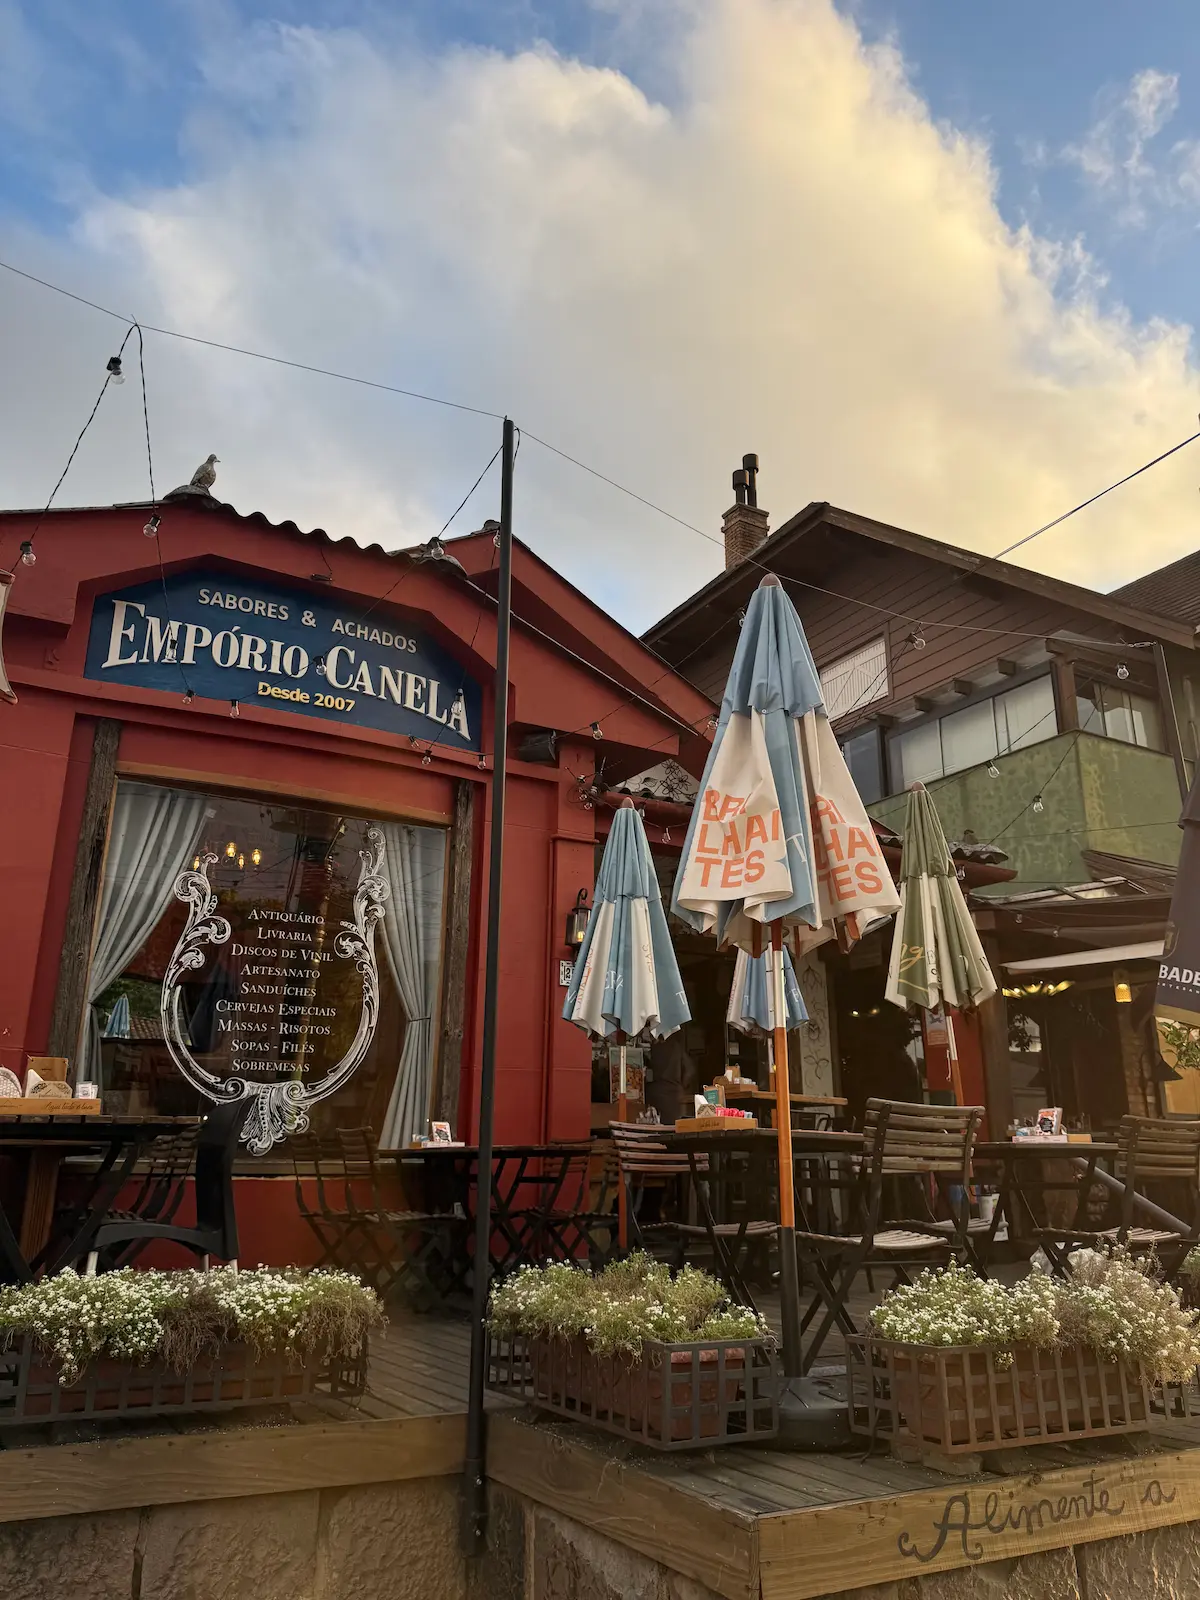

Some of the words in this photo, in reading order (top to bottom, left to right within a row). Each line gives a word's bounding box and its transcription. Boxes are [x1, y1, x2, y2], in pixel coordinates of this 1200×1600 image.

[198, 588, 289, 620] SABORES
[301, 610, 317, 628] &
[331, 619, 417, 654] ACHADOS
[101, 600, 309, 678] EMPÓRIO
[326, 645, 471, 741] CANELA
[257, 682, 310, 704] Desde
[313, 693, 356, 712] 2007
[695, 849, 765, 888] TES
[248, 909, 325, 924] ANTIQUÁRIO
[257, 926, 312, 941] LIVRARIA
[231, 943, 277, 957] DISCOS
[301, 949, 333, 962] VINIL
[240, 963, 320, 979] ARTESANATO
[240, 982, 317, 998] SANDUÍCHES
[215, 999, 274, 1014] CERVEJAS
[278, 1003, 336, 1017] ESPECIAIS
[217, 1019, 268, 1032] MASSAS
[279, 1022, 331, 1036] RISOTOS
[230, 1039, 270, 1052] SOPAS
[281, 1041, 315, 1054] FILÉS
[231, 1059, 310, 1073] SOBREMESAS
[898, 1469, 1125, 1562] Alimente
